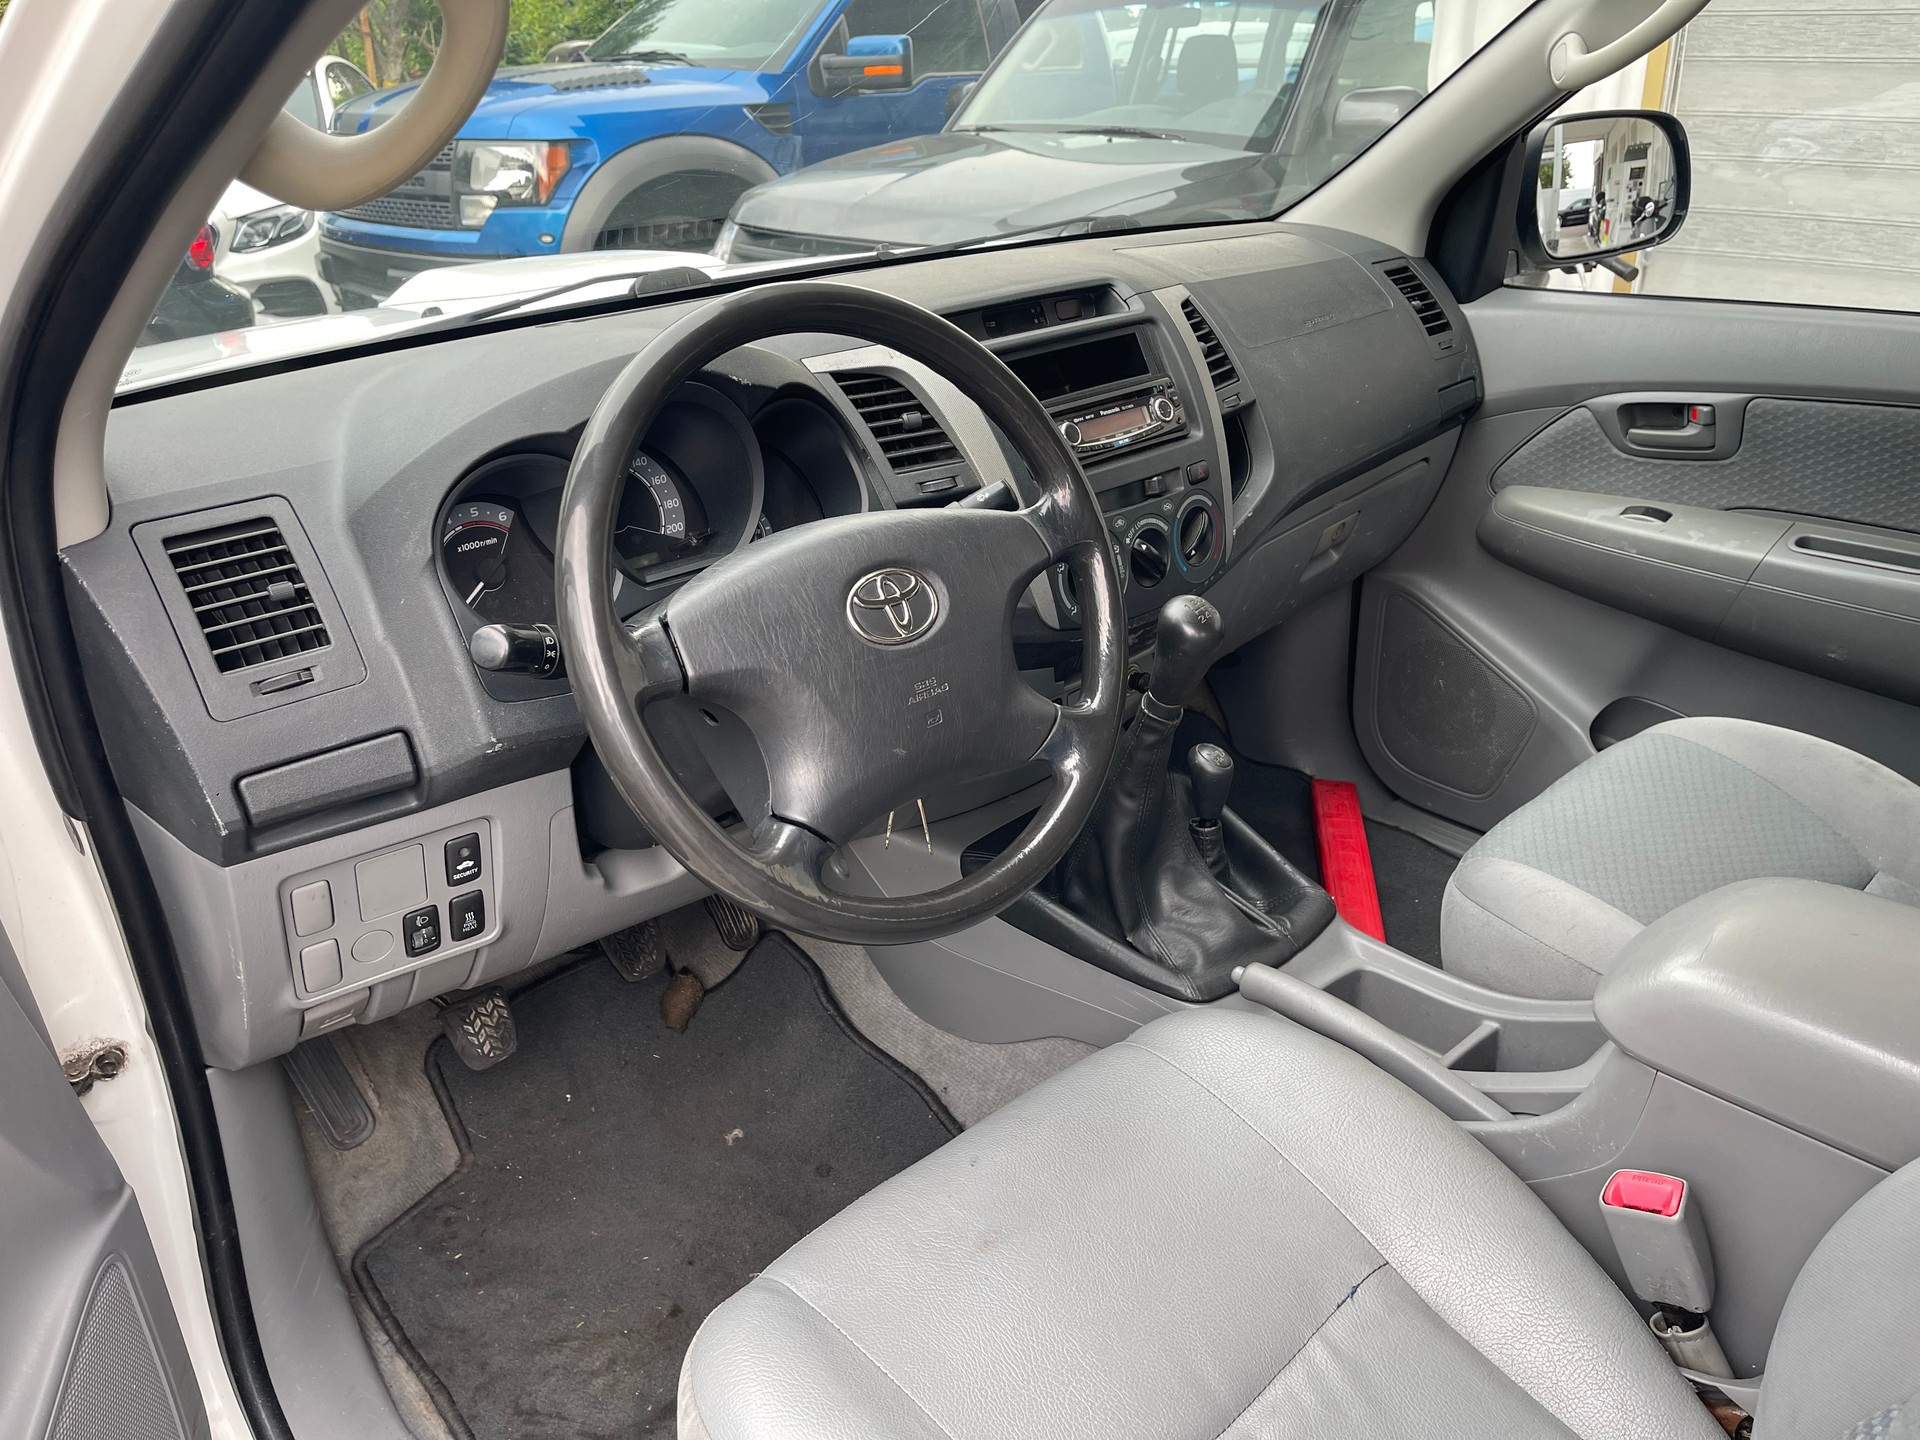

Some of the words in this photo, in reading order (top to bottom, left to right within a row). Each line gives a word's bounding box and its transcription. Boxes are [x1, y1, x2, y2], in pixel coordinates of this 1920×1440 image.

[651, 474, 667, 485] 160
[663, 498, 680, 509] 180
[470, 507, 479, 517] 5
[498, 511, 507, 521] 6
[666, 521, 684, 534] 200
[453, 867, 479, 880] SECURITY
[462, 923, 478, 932] HEAT
[1631, 1174, 1666, 1186] PRESS
